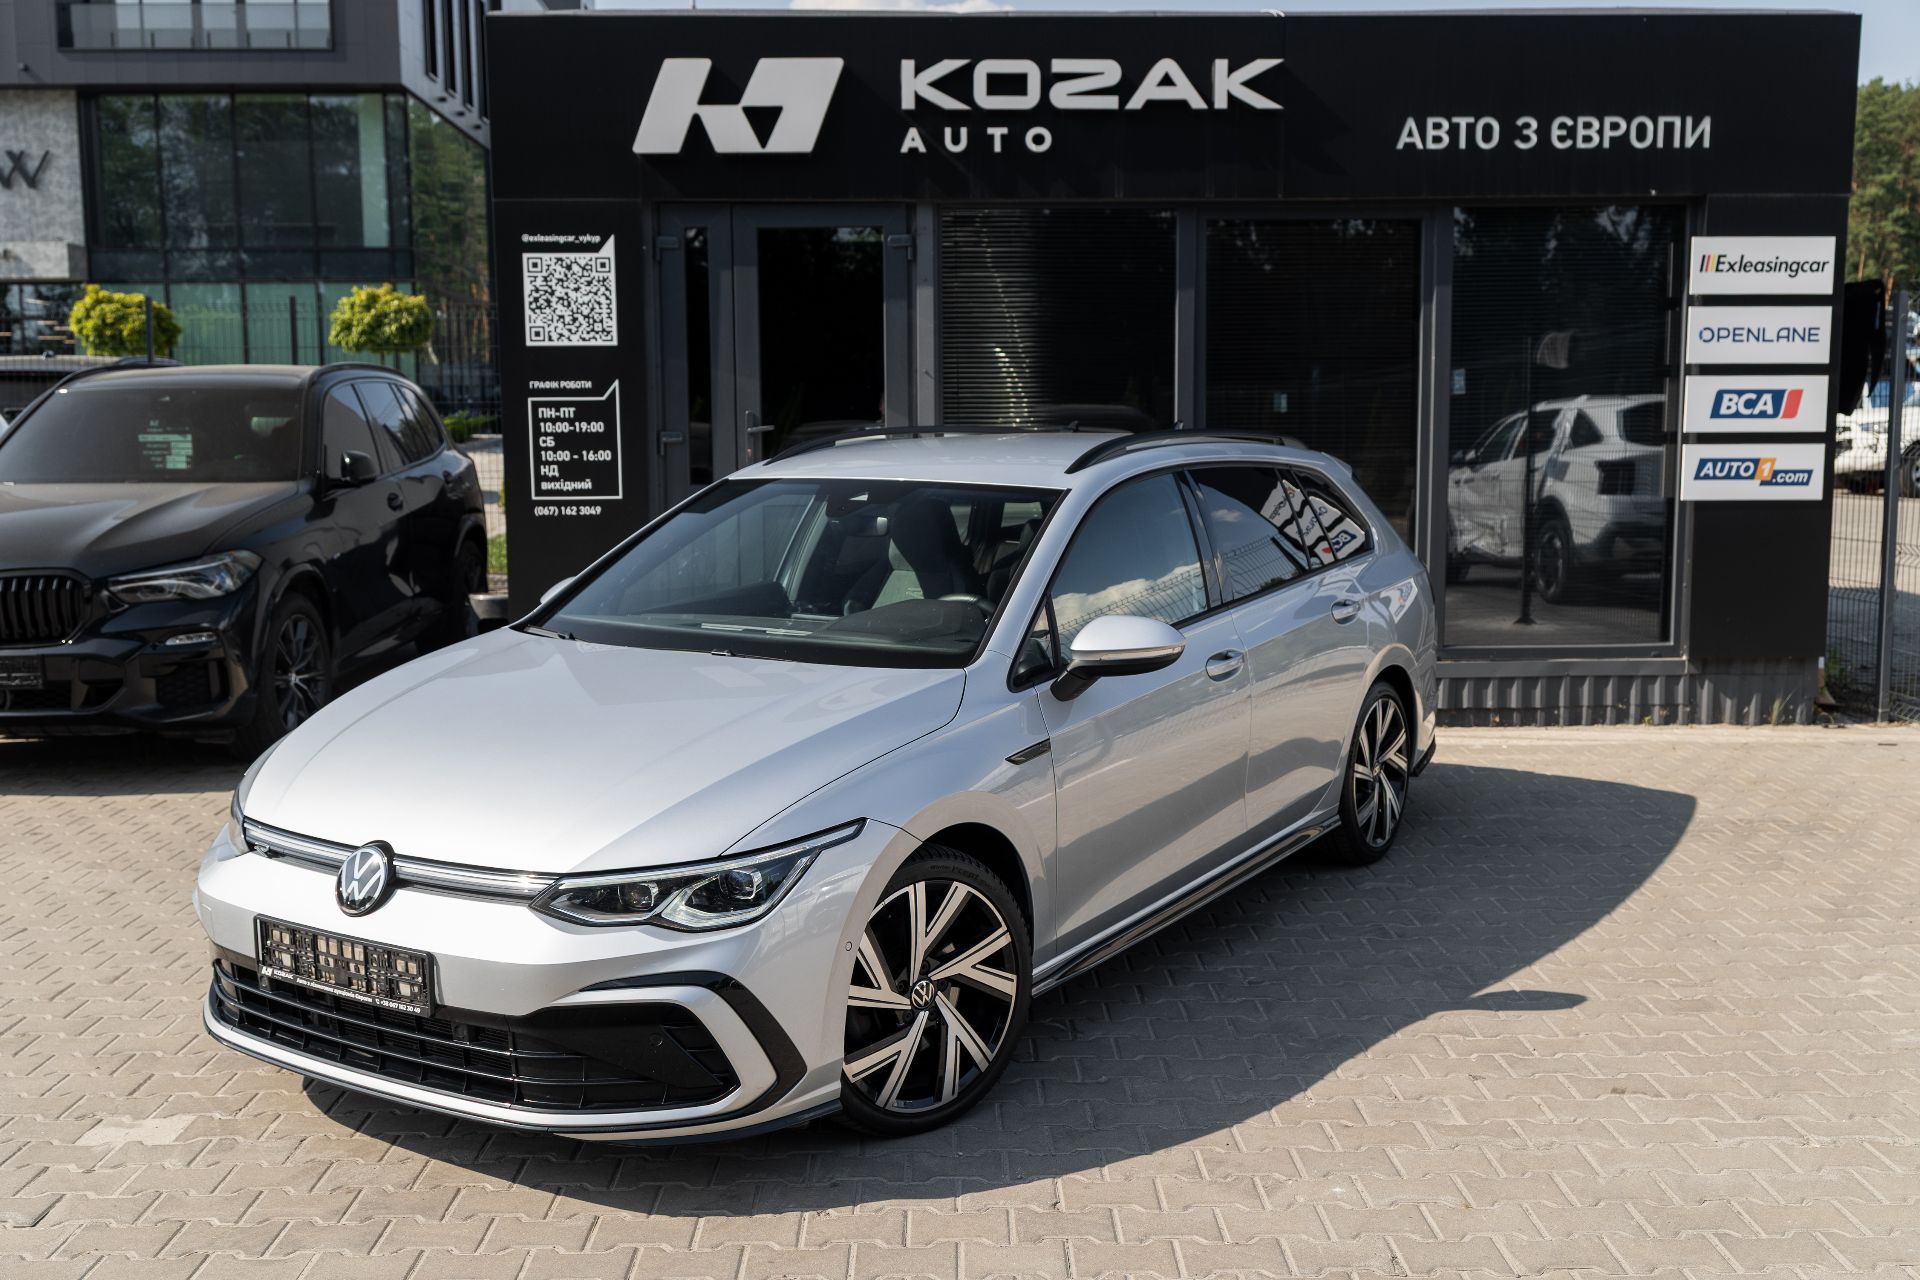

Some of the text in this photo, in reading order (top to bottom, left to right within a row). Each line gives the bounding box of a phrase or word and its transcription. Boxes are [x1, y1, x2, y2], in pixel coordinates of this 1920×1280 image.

[900, 58, 1285, 110] KOZAK
[1396, 115, 1712, 150] АВТО З ЄВРОПИ
[900, 126, 1053, 153] AUTO
[1715, 254, 1830, 278] Exleasingcar
[1698, 326, 1821, 344] OPENLANE
[528, 380, 593, 389] ГРАФІК РОБОТИ
[1719, 393, 1774, 416] BCA
[538, 407, 576, 419] ПН-ПТ
[540, 421, 605, 433] 10:00-19:00
[539, 436, 556, 447] СБ
[540, 450, 571, 462] 10:00
[582, 450, 612, 461] 16:00
[540, 465, 560, 477] НД
[1700, 461, 1809, 484] AUTO1.com
[541, 478, 593, 491] вихідний
[533, 505, 602, 517] (067) 162 3049
